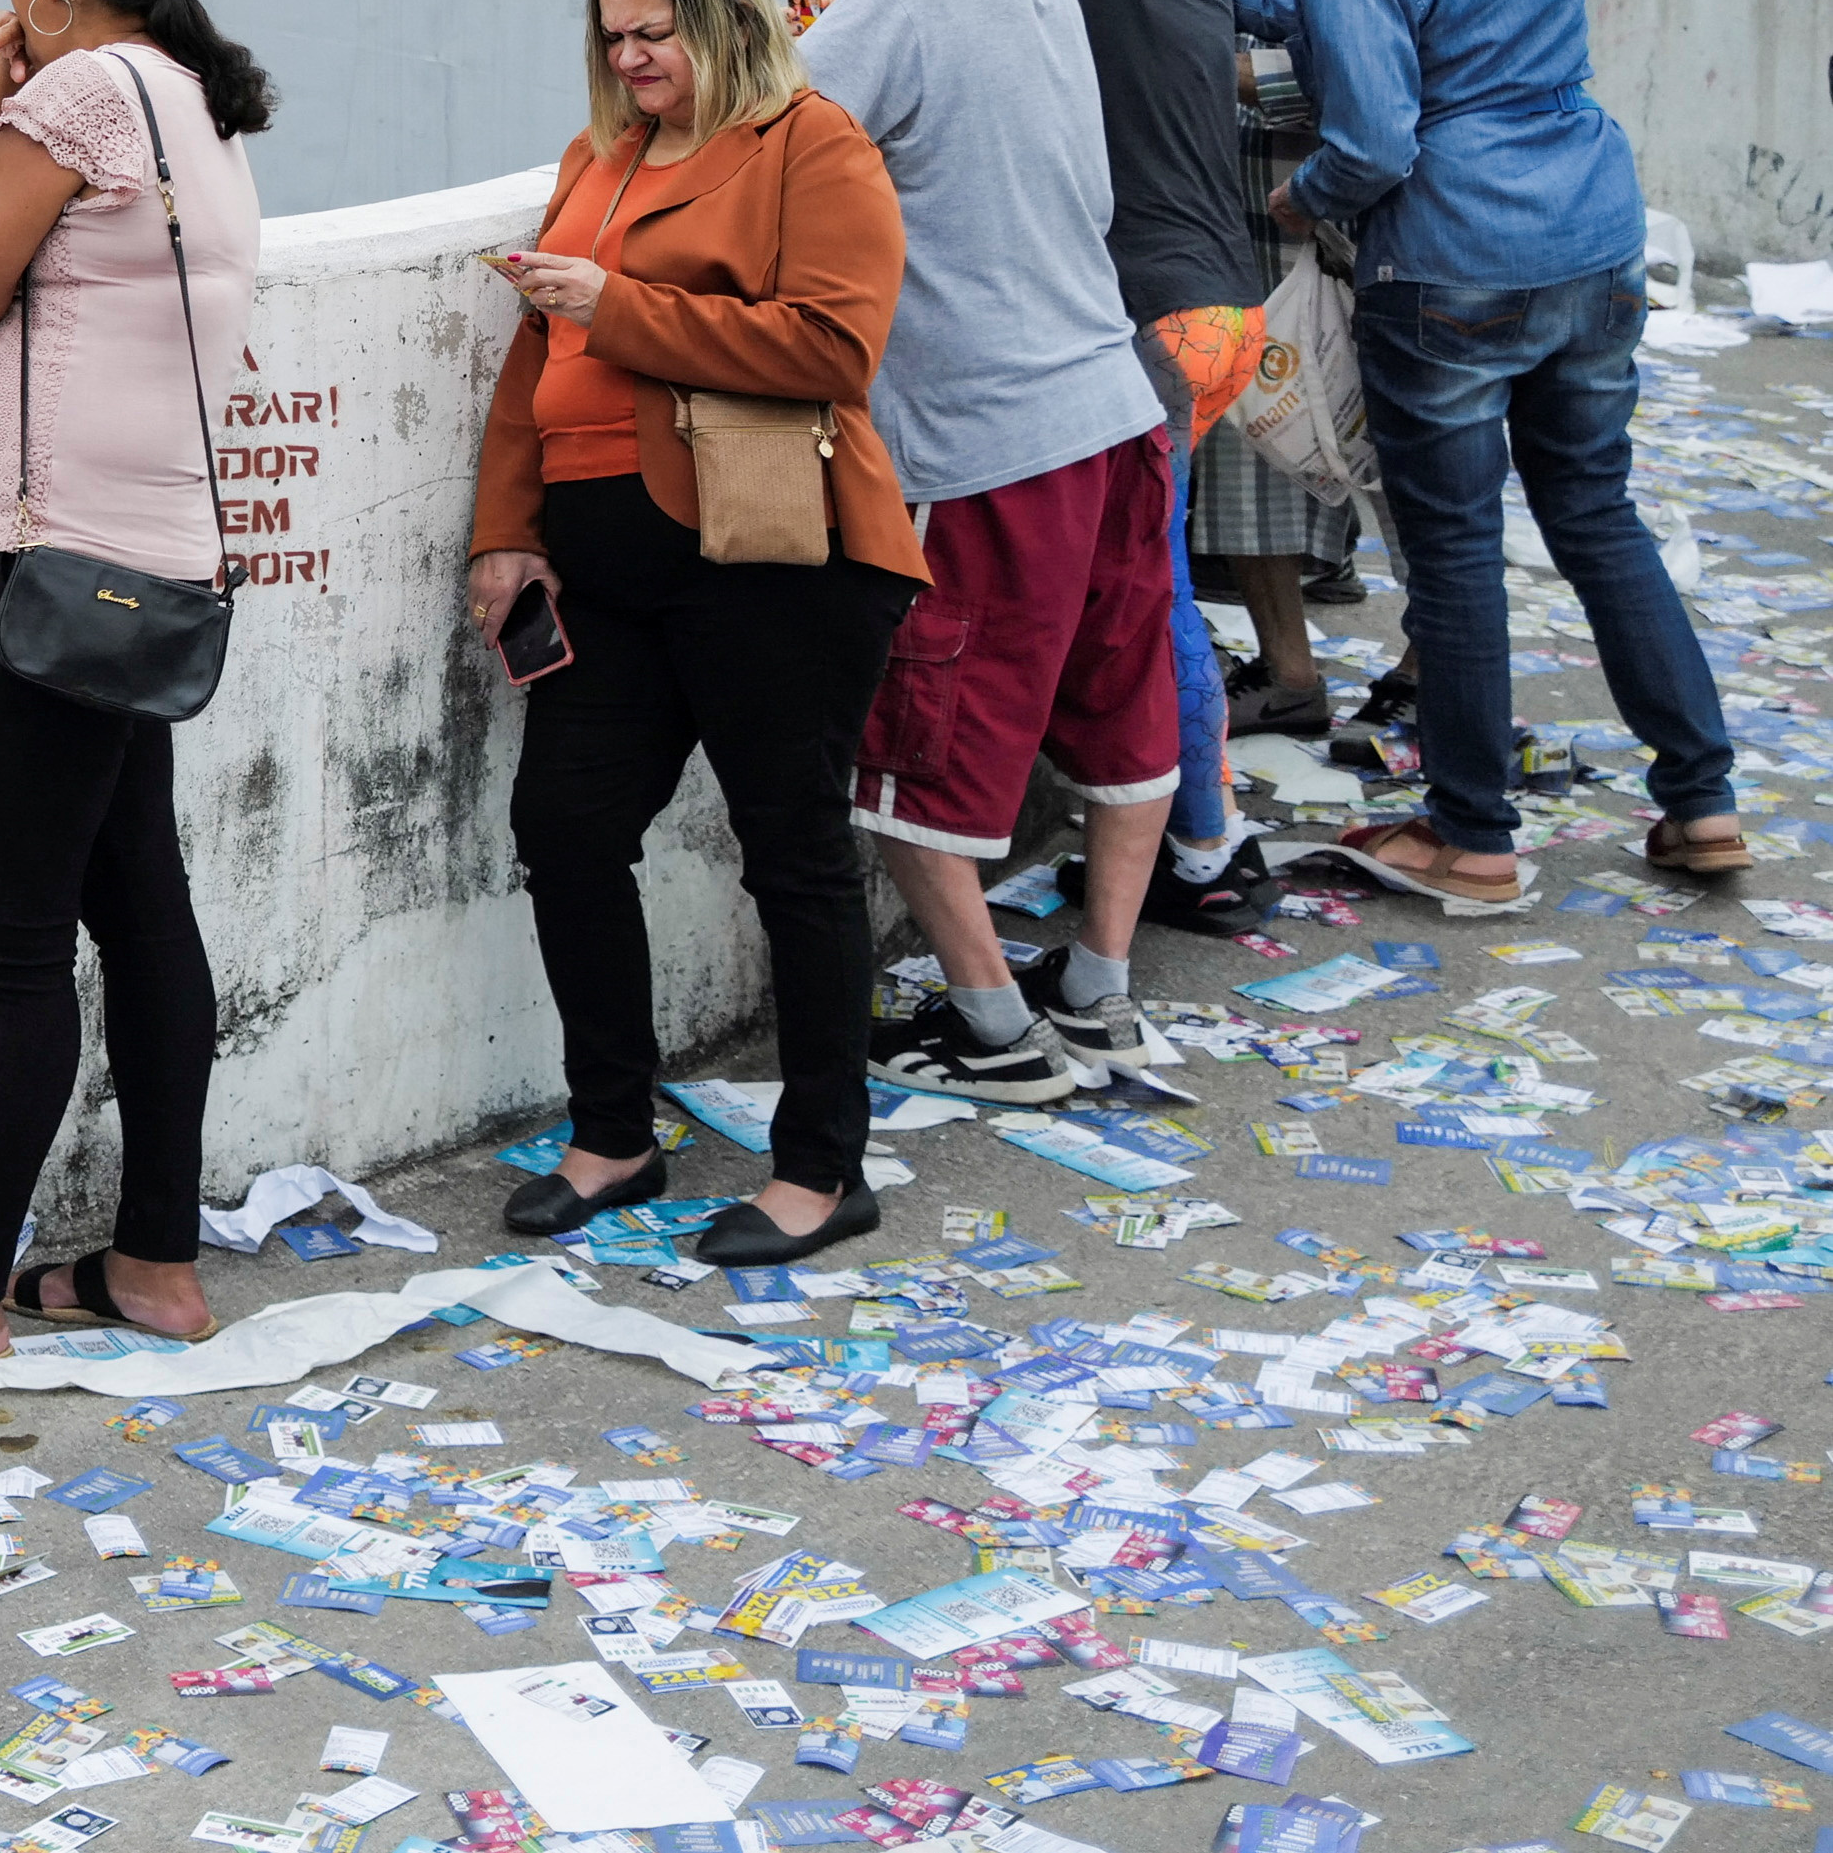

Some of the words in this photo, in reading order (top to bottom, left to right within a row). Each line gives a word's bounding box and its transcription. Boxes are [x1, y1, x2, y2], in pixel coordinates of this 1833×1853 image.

[216, 444, 320, 480] DOR
[180, 1686, 217, 1696] 4000
[1399, 1742, 1445, 1755] 7712
